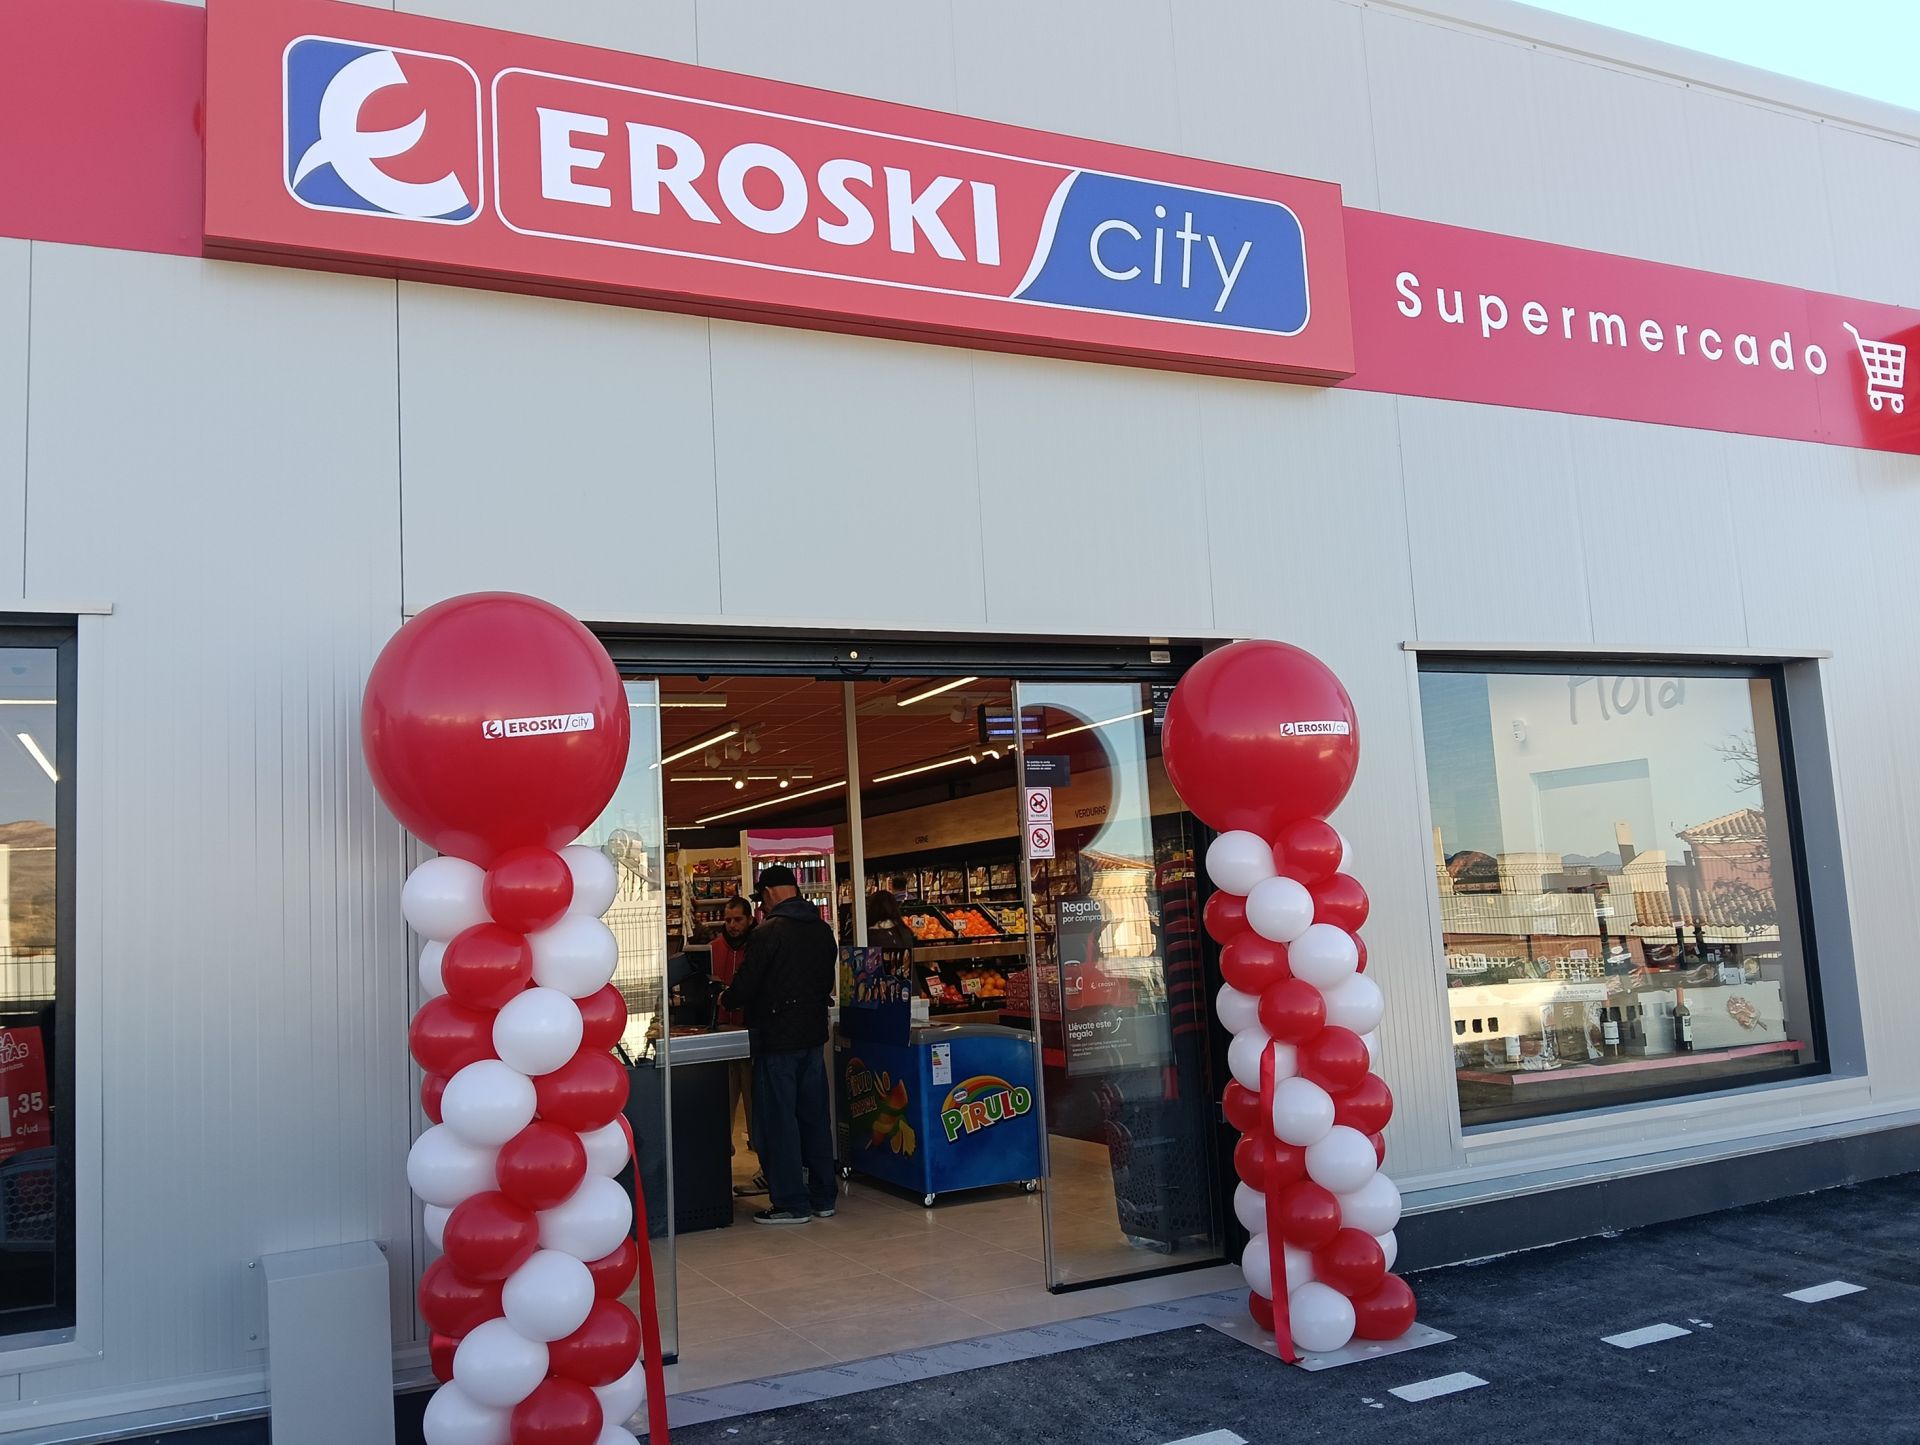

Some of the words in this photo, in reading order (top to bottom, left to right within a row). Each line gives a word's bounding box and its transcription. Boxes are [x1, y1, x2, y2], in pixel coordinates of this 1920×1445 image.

[536, 106, 1000, 267] EROSKI
[1089, 205, 1253, 313] city
[1396, 271, 1829, 376] Supermercado
[509, 718, 562, 734] EROSKI
[571, 716, 589, 729] city
[1297, 723, 1332, 733] EROSKI
[1061, 900, 1101, 915] Regalo
[1062, 916, 1074, 925] por
[1068, 1022, 1095, 1031] Llévate
[1095, 1020, 1112, 1029] este
[1069, 1030, 1093, 1040] regalo
